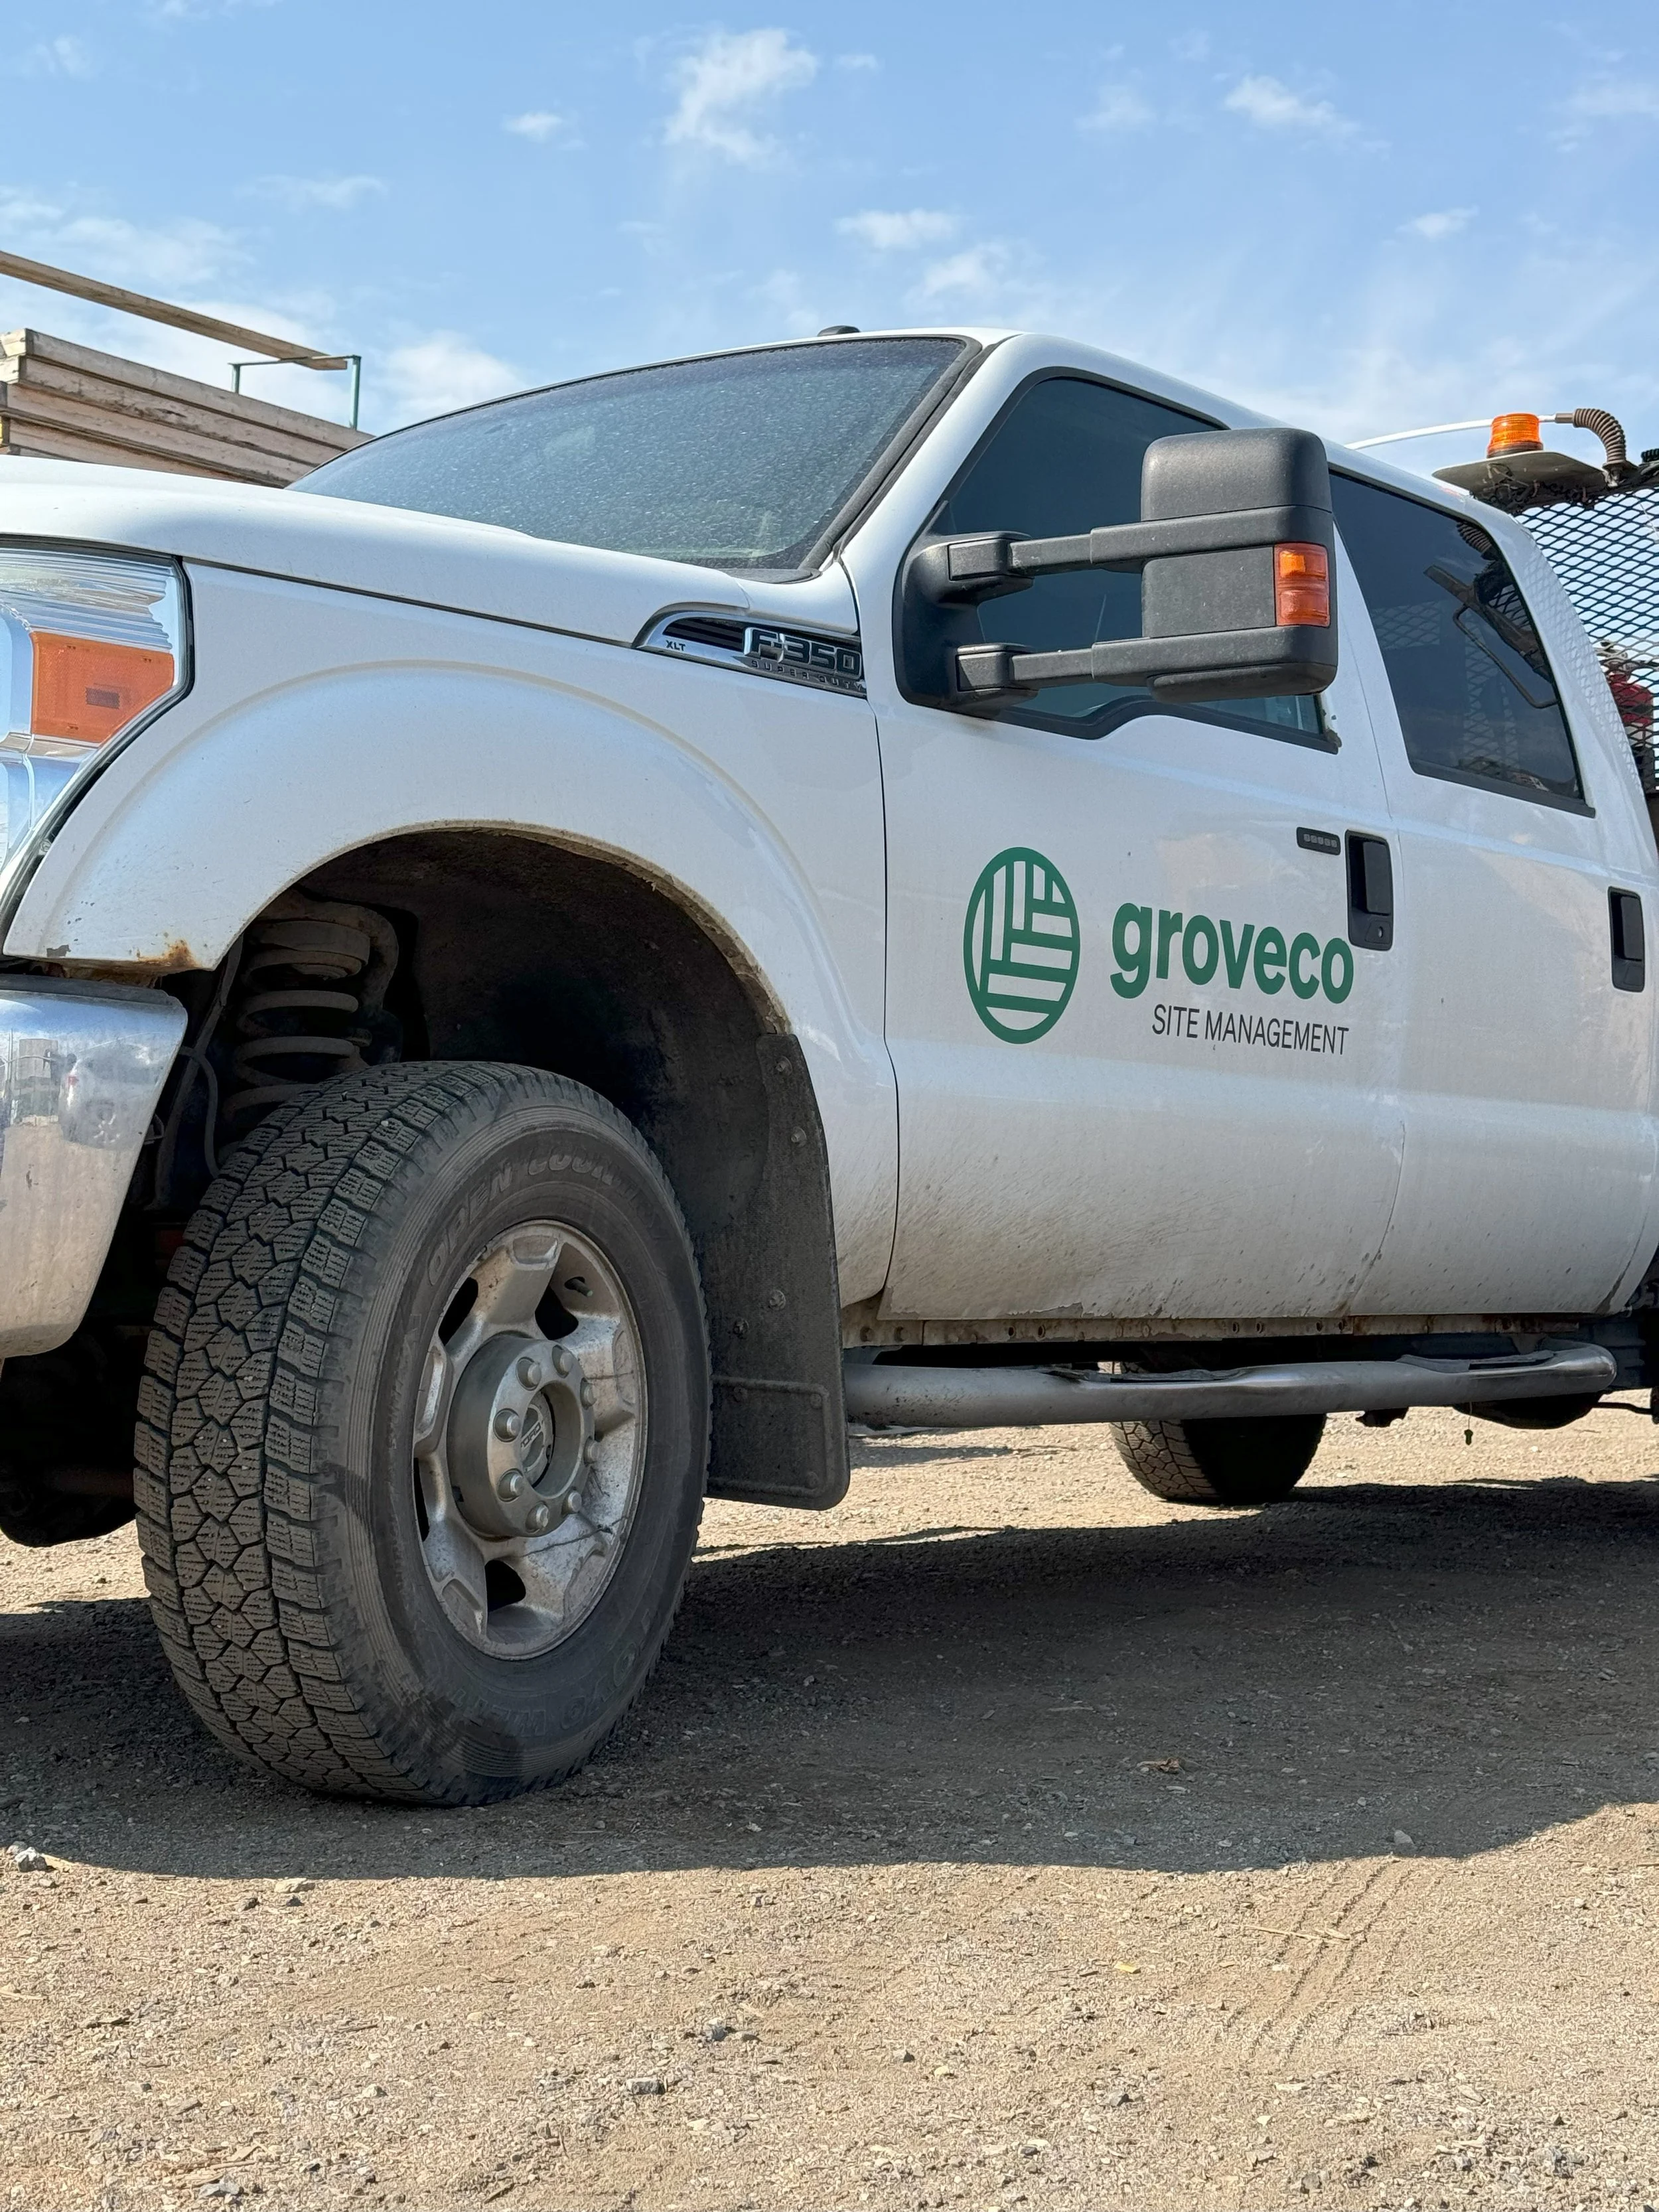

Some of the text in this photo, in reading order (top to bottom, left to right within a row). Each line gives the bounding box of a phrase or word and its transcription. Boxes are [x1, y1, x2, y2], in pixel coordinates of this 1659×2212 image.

[666, 640, 686, 652] XLT
[744, 627, 862, 679] F-350
[751, 660, 865, 691] SUPER DUTY
[1110, 903, 1354, 1003] groveco
[1153, 1004, 1350, 1055] SITE MANAGEMENT
[427, 1161, 512, 1286] OPEN
